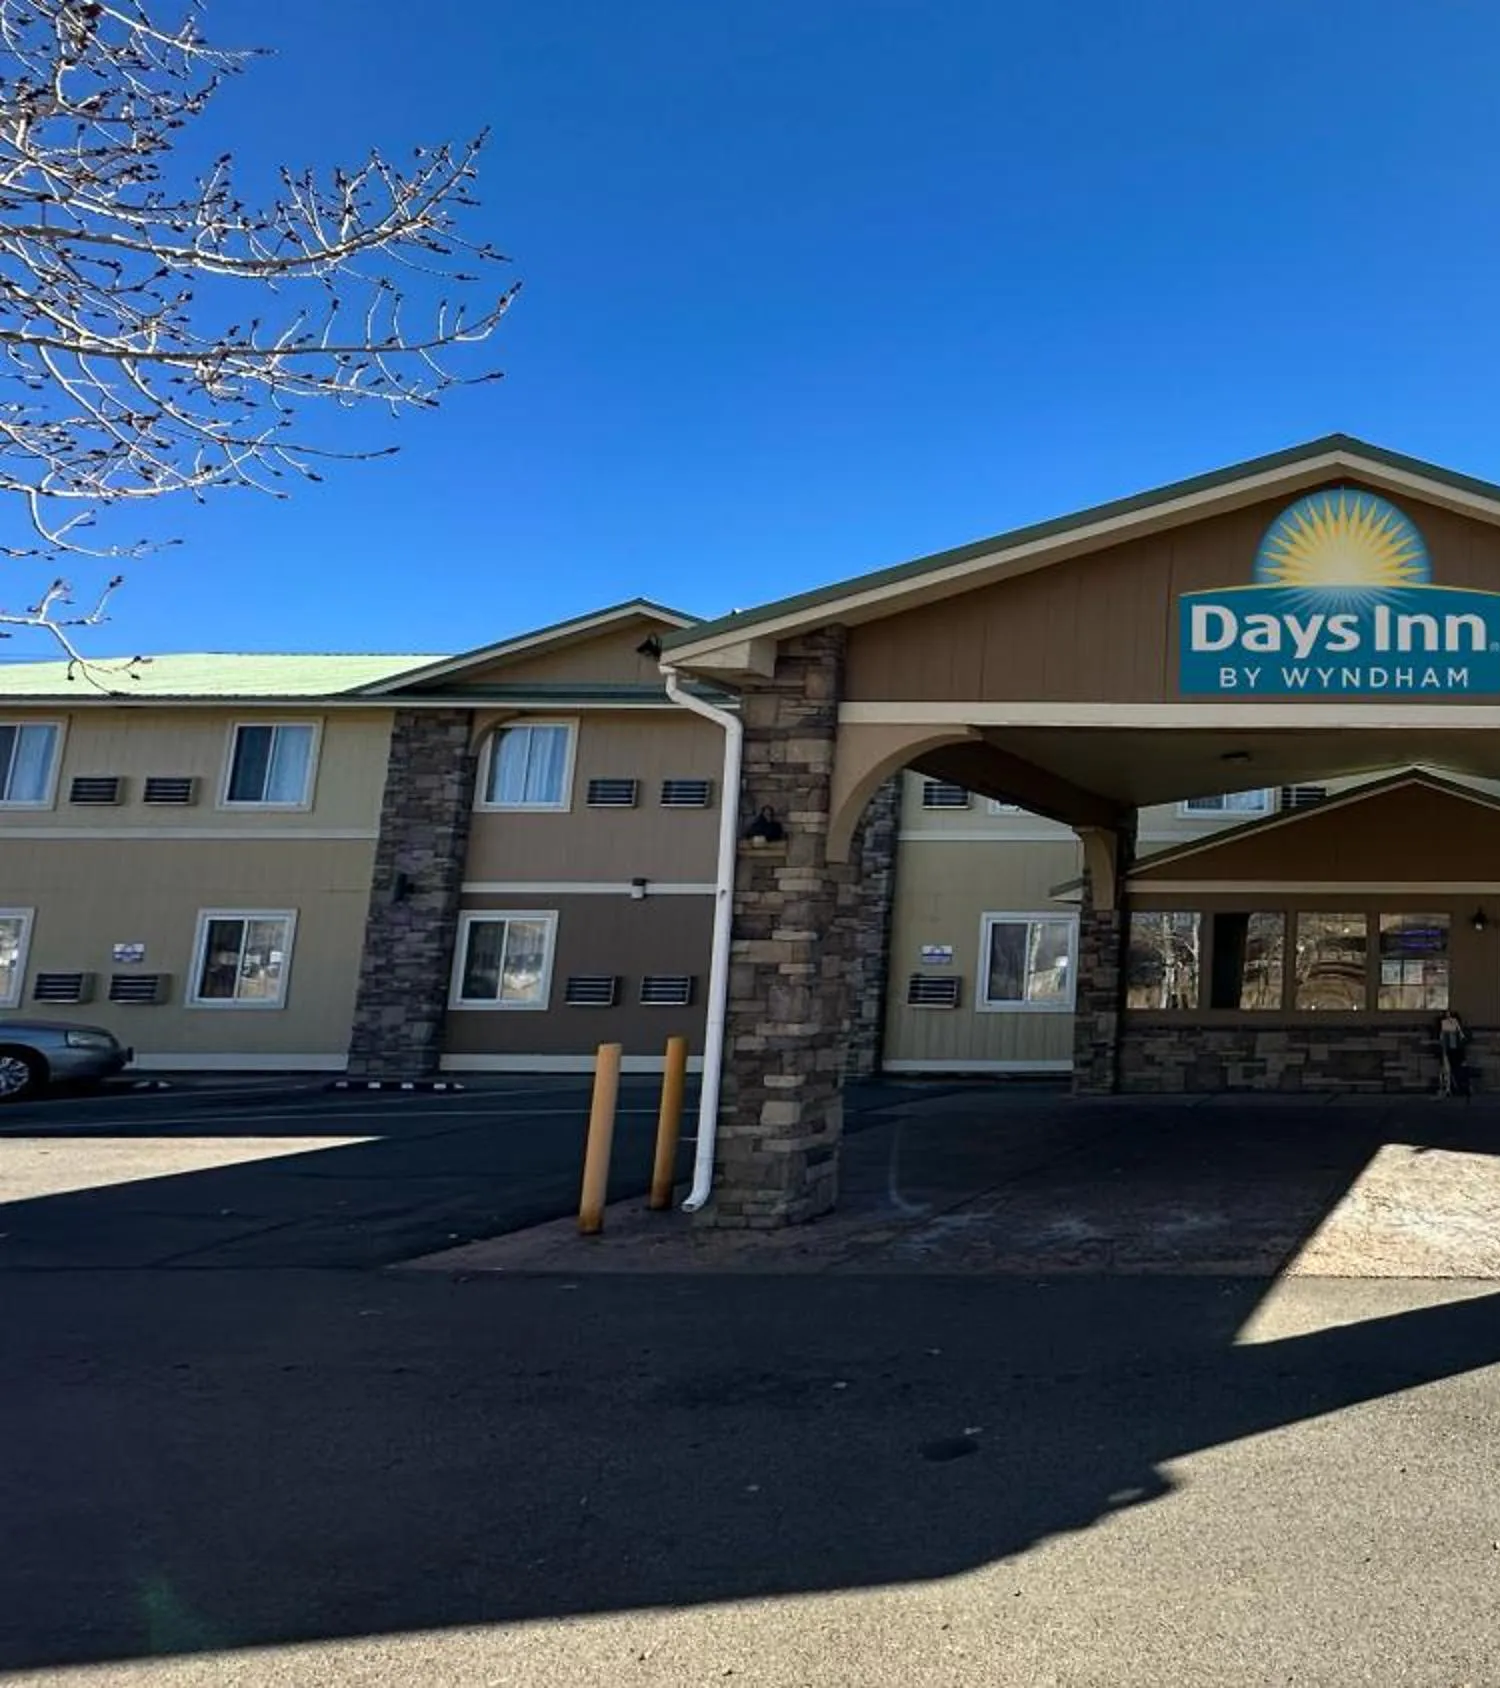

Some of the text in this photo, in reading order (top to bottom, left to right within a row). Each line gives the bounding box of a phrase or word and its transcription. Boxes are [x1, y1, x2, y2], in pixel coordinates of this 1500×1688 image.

[1191, 604, 1487, 659] Days Inn
[1219, 666, 1469, 689] BY WYNDHAM
